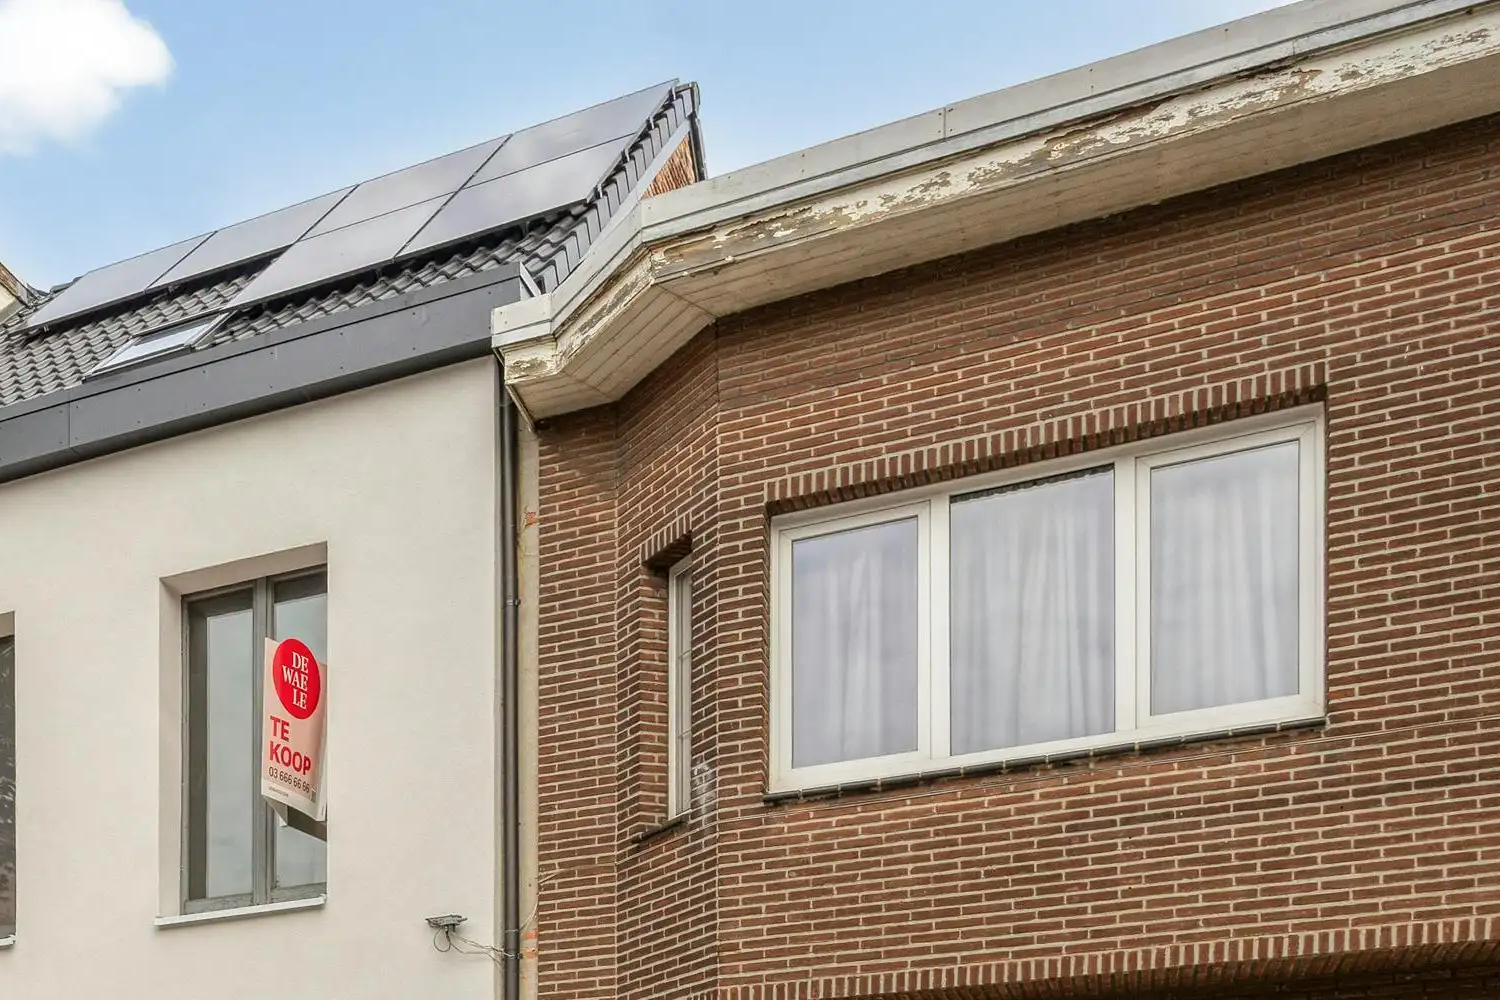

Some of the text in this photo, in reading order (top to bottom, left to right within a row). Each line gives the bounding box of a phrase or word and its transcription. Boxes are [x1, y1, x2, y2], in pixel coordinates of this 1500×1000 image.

[292, 651, 309, 674] DE
[282, 664, 309, 691] WAE
[292, 688, 308, 710] LE
[270, 715, 290, 742] TE
[269, 741, 312, 776] KOOP
[268, 766, 278, 779] 03
[279, 770, 292, 785] 666
[293, 776, 302, 789] 66
